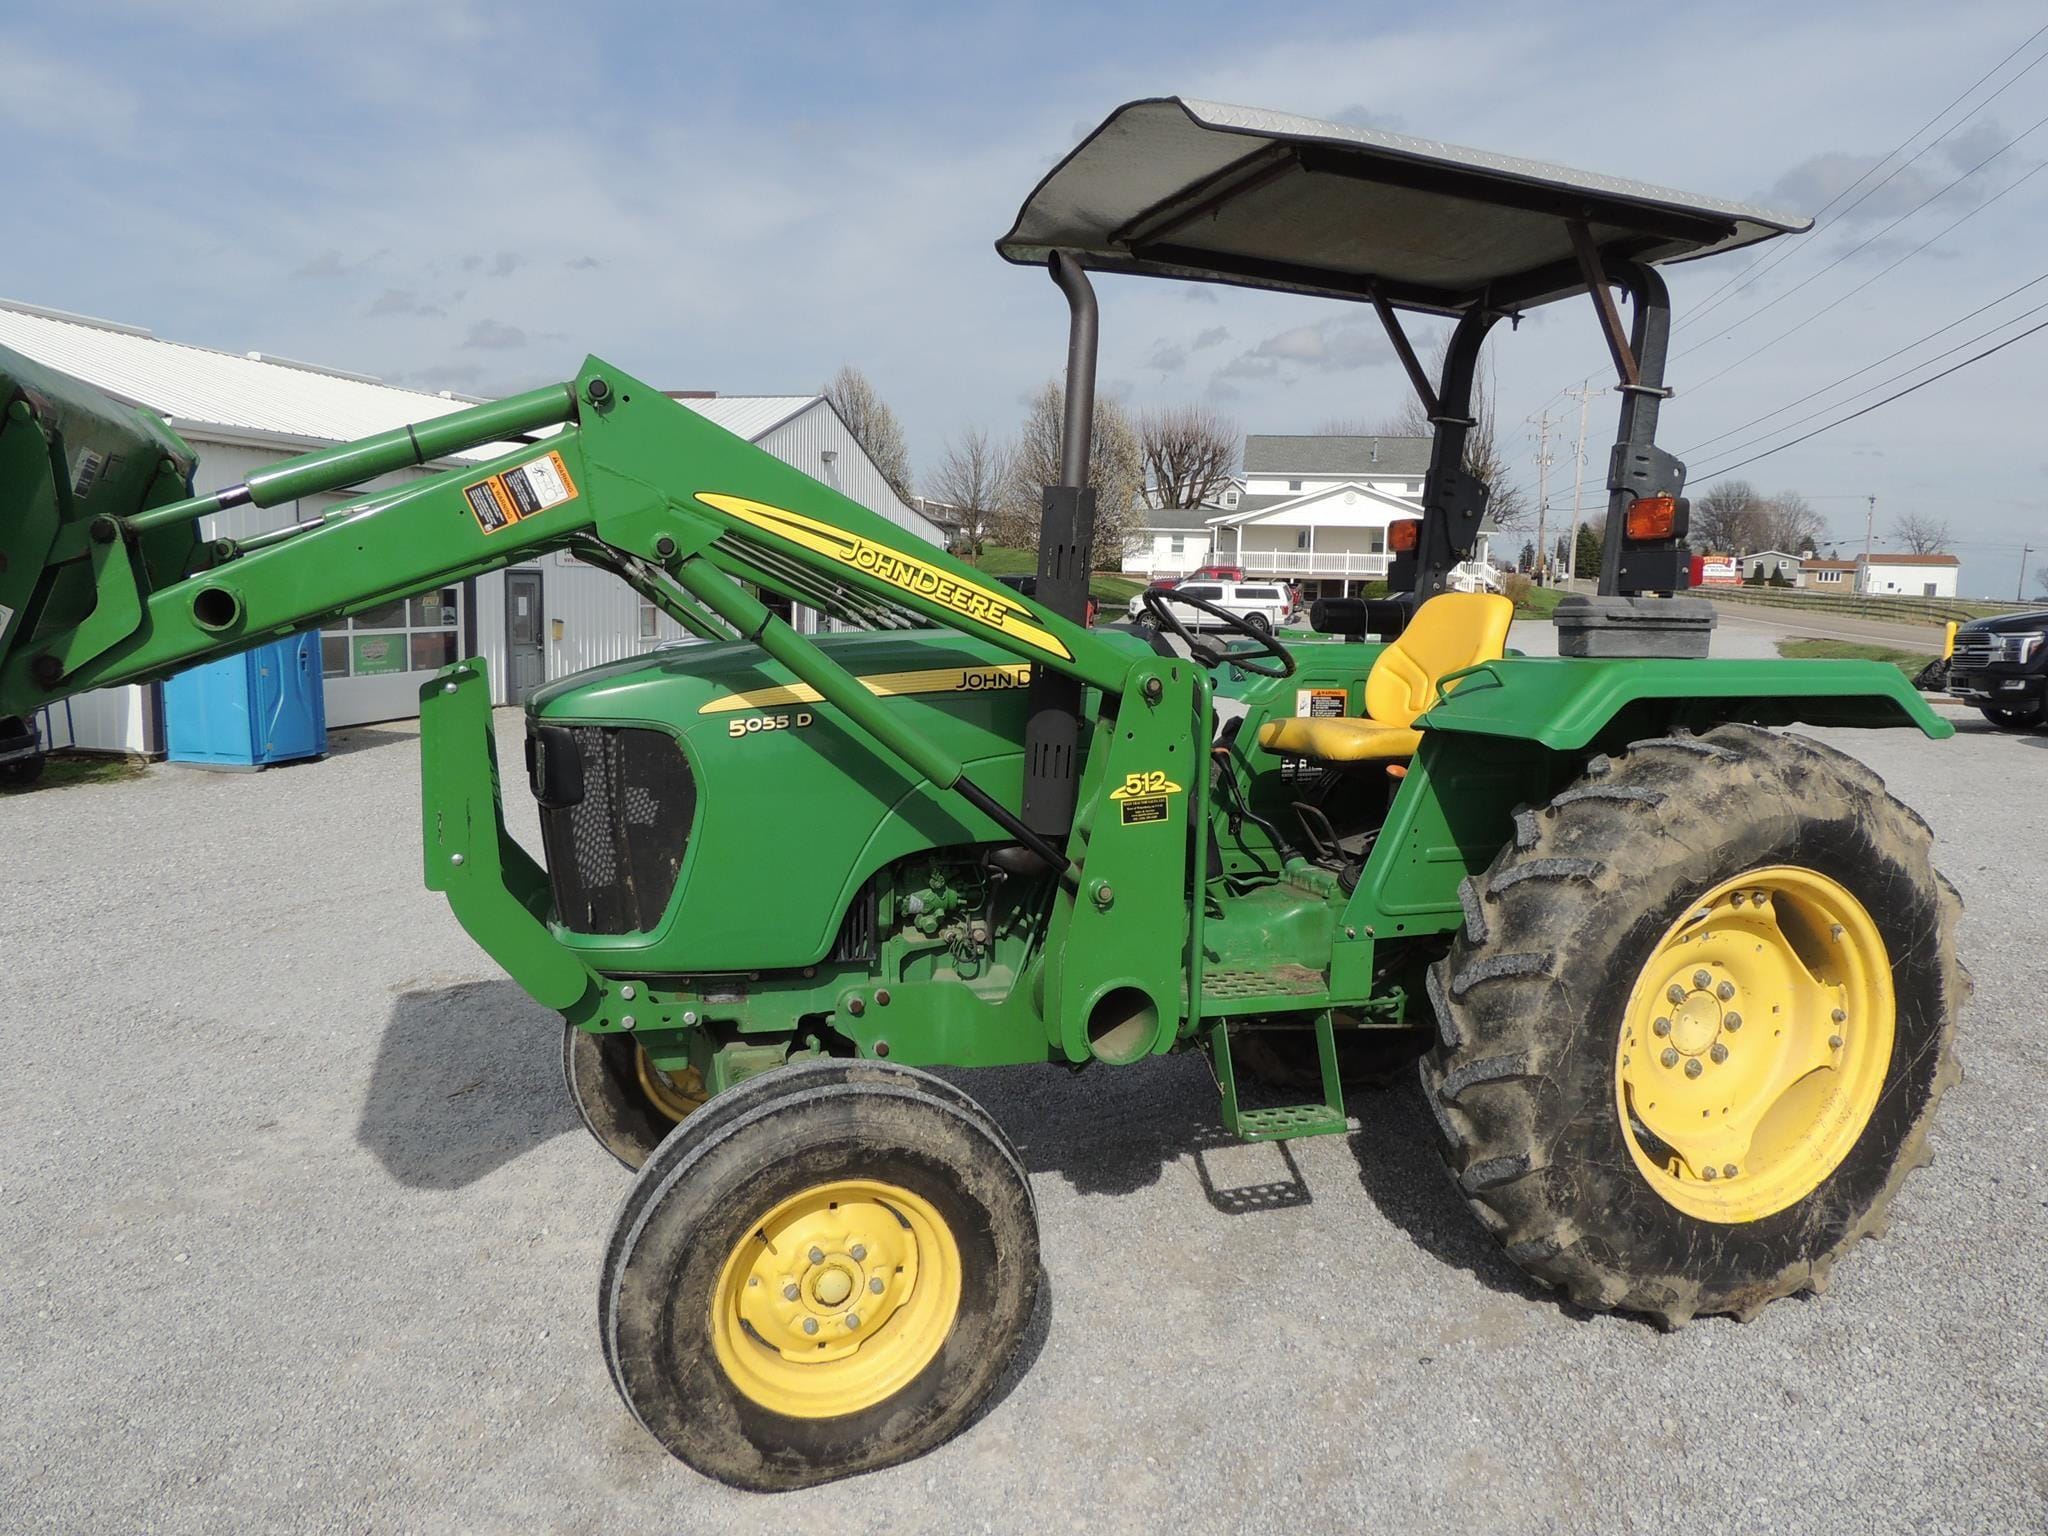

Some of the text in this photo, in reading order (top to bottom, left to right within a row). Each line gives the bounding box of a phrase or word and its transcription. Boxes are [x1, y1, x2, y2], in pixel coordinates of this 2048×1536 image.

[556, 463, 574, 493] WARNING
[495, 490, 513, 520] WARNING
[840, 539, 1007, 626] JOHN DEERE
[956, 671, 1012, 691] JOHN
[728, 713, 813, 738] 5055 D
[1126, 771, 1166, 796] 512
